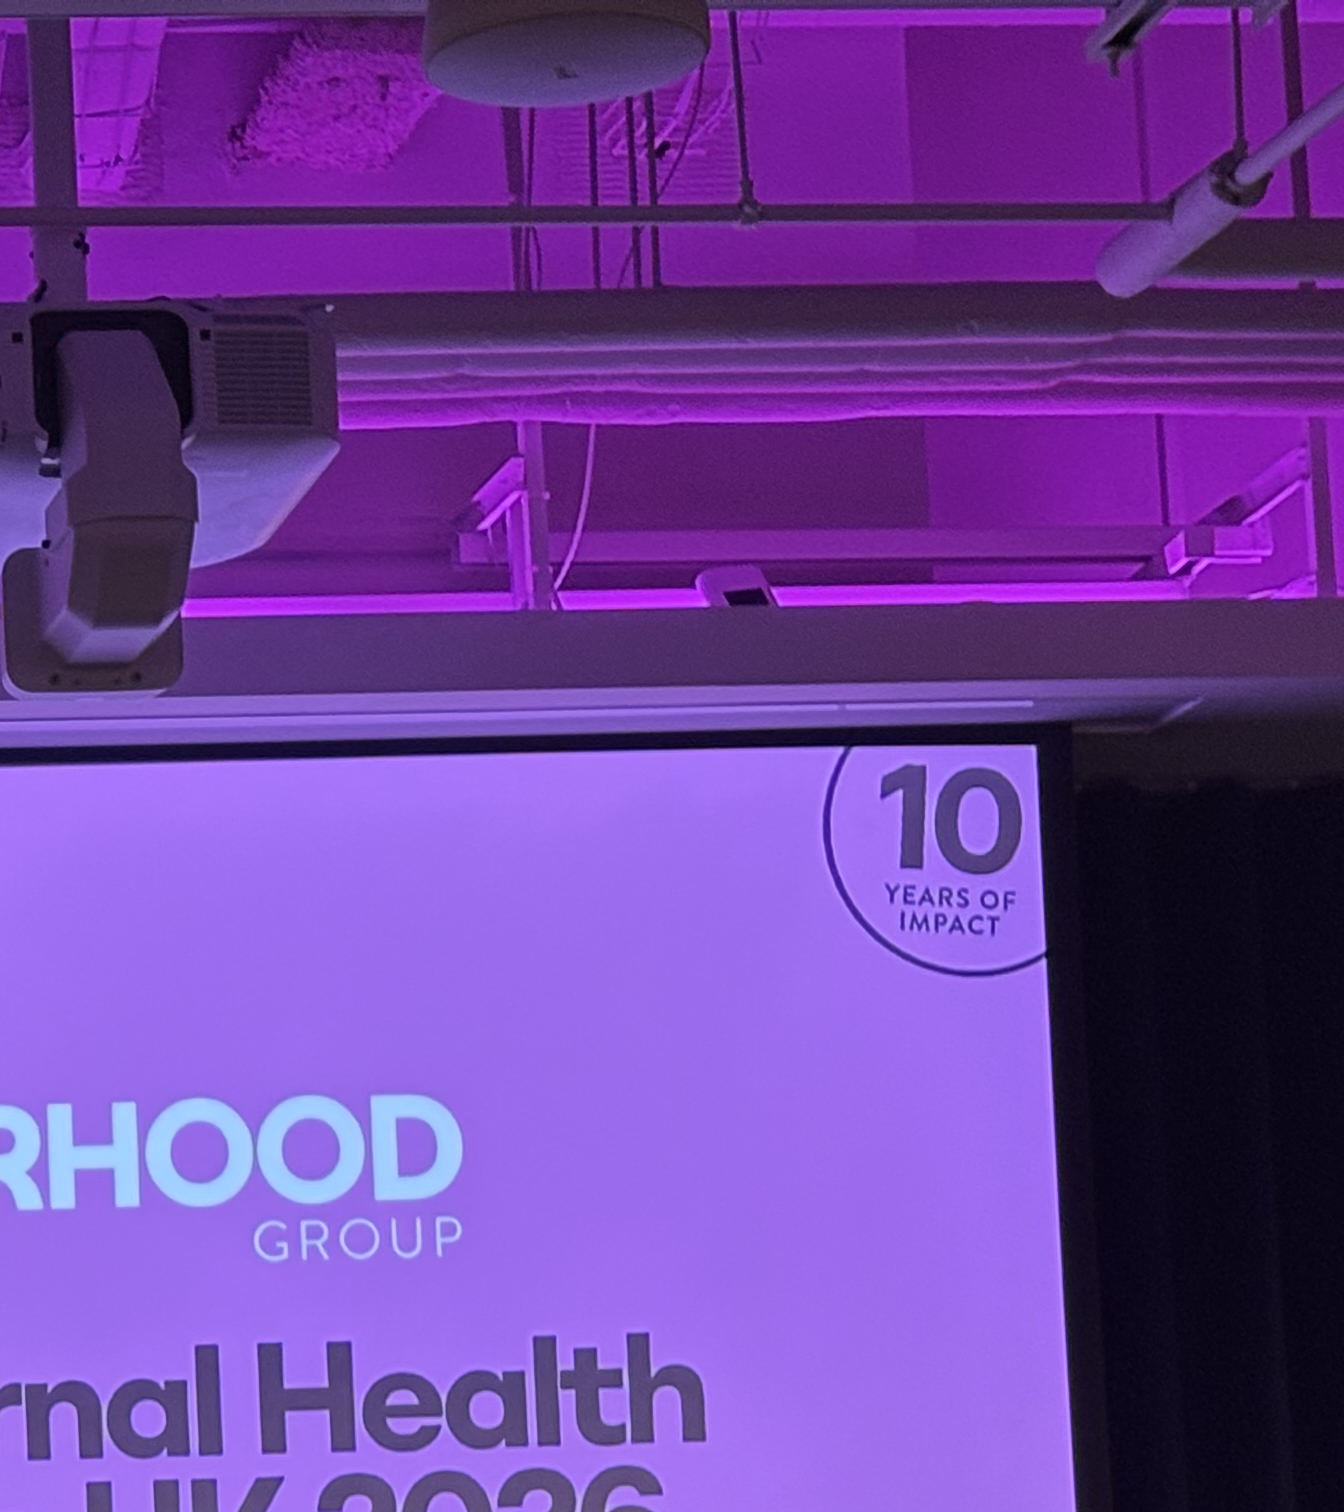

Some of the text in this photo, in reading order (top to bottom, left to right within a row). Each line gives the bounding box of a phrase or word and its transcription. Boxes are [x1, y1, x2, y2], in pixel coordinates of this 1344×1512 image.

[880, 763, 1023, 875] 10
[884, 882, 1016, 912] YEARS OF
[899, 910, 1001, 937] IMPACT
[253, 1216, 463, 1262] GROUP
[256, 1332, 708, 1454] Health
